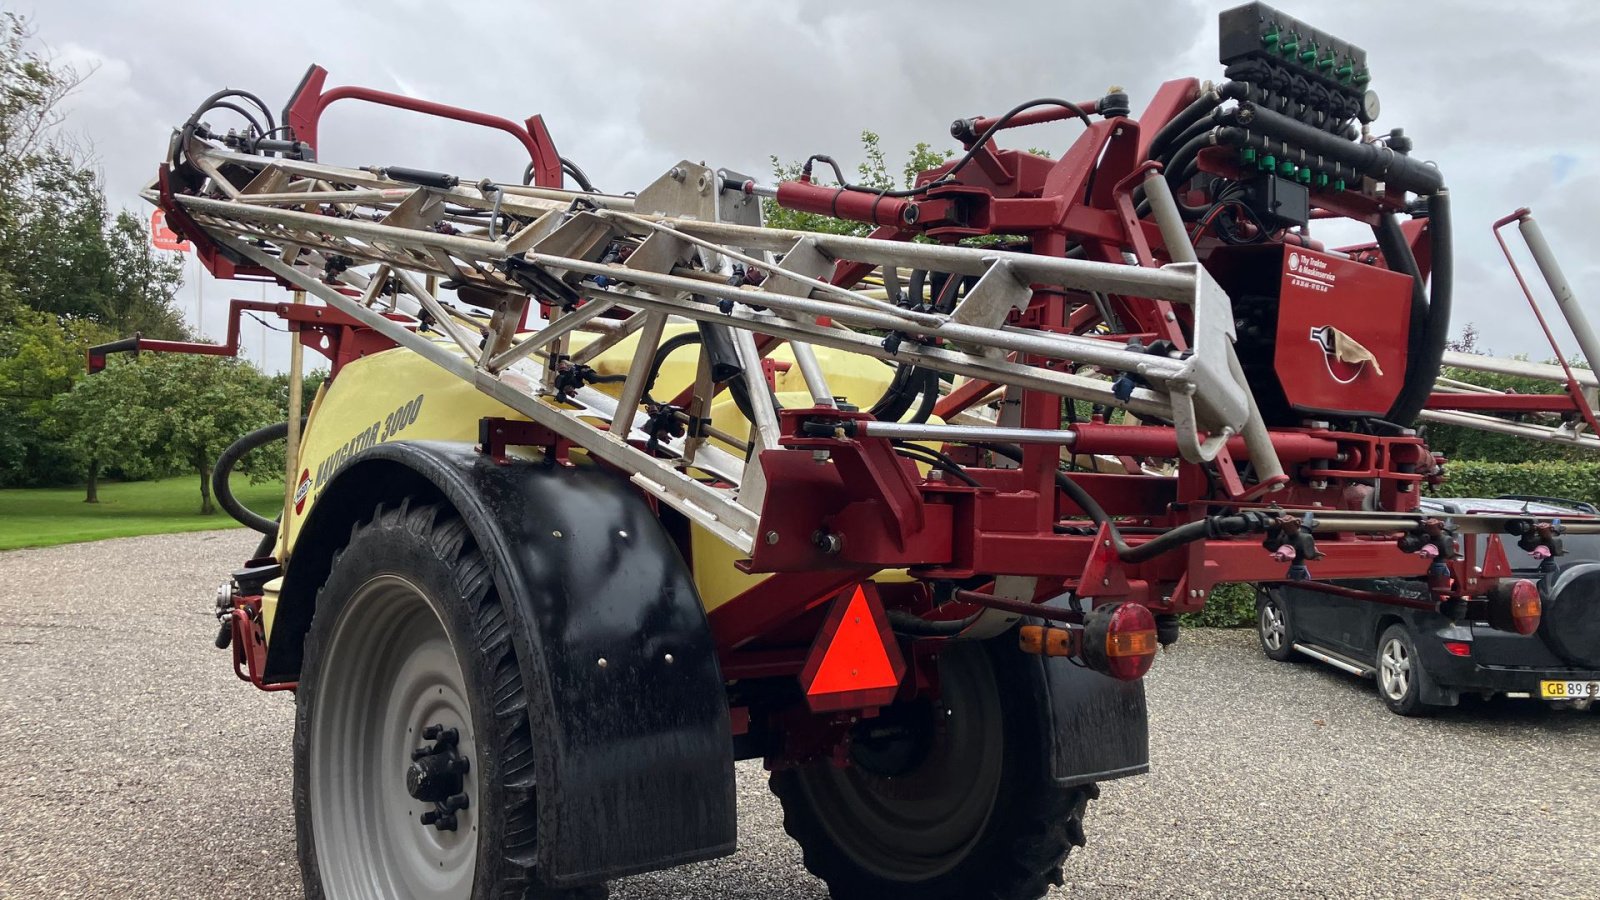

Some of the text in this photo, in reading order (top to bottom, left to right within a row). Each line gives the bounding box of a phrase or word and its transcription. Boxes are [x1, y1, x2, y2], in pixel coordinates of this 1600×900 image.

[314, 394, 424, 490] NAVIGATOR 3000
[1547, 683, 1565, 695] GB
[1567, 683, 1582, 695] 89
